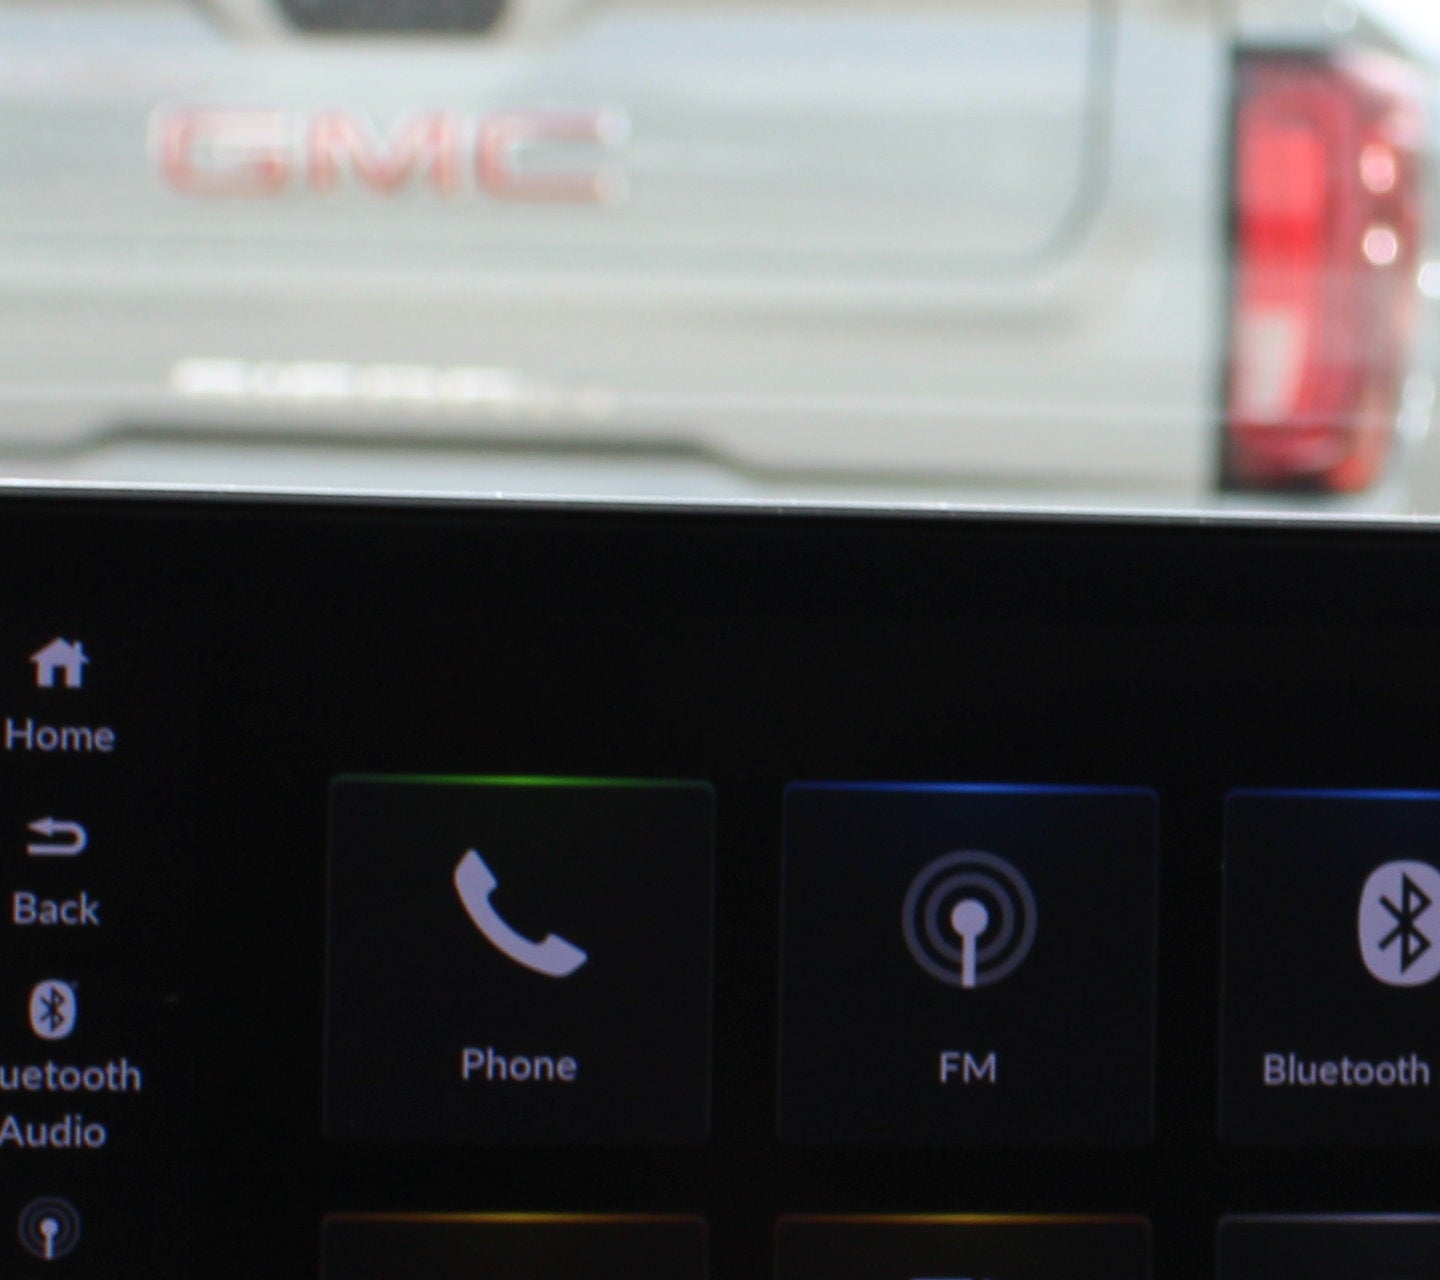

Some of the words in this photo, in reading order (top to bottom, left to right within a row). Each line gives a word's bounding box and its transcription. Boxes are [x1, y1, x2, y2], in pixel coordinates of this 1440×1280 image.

[150, 104, 628, 202] GMC
[3, 716, 117, 753] Home
[11, 890, 100, 926] Back
[460, 1046, 579, 1082] Phone
[938, 1050, 998, 1084] FM
[1262, 1051, 1432, 1087] Bluetooth
